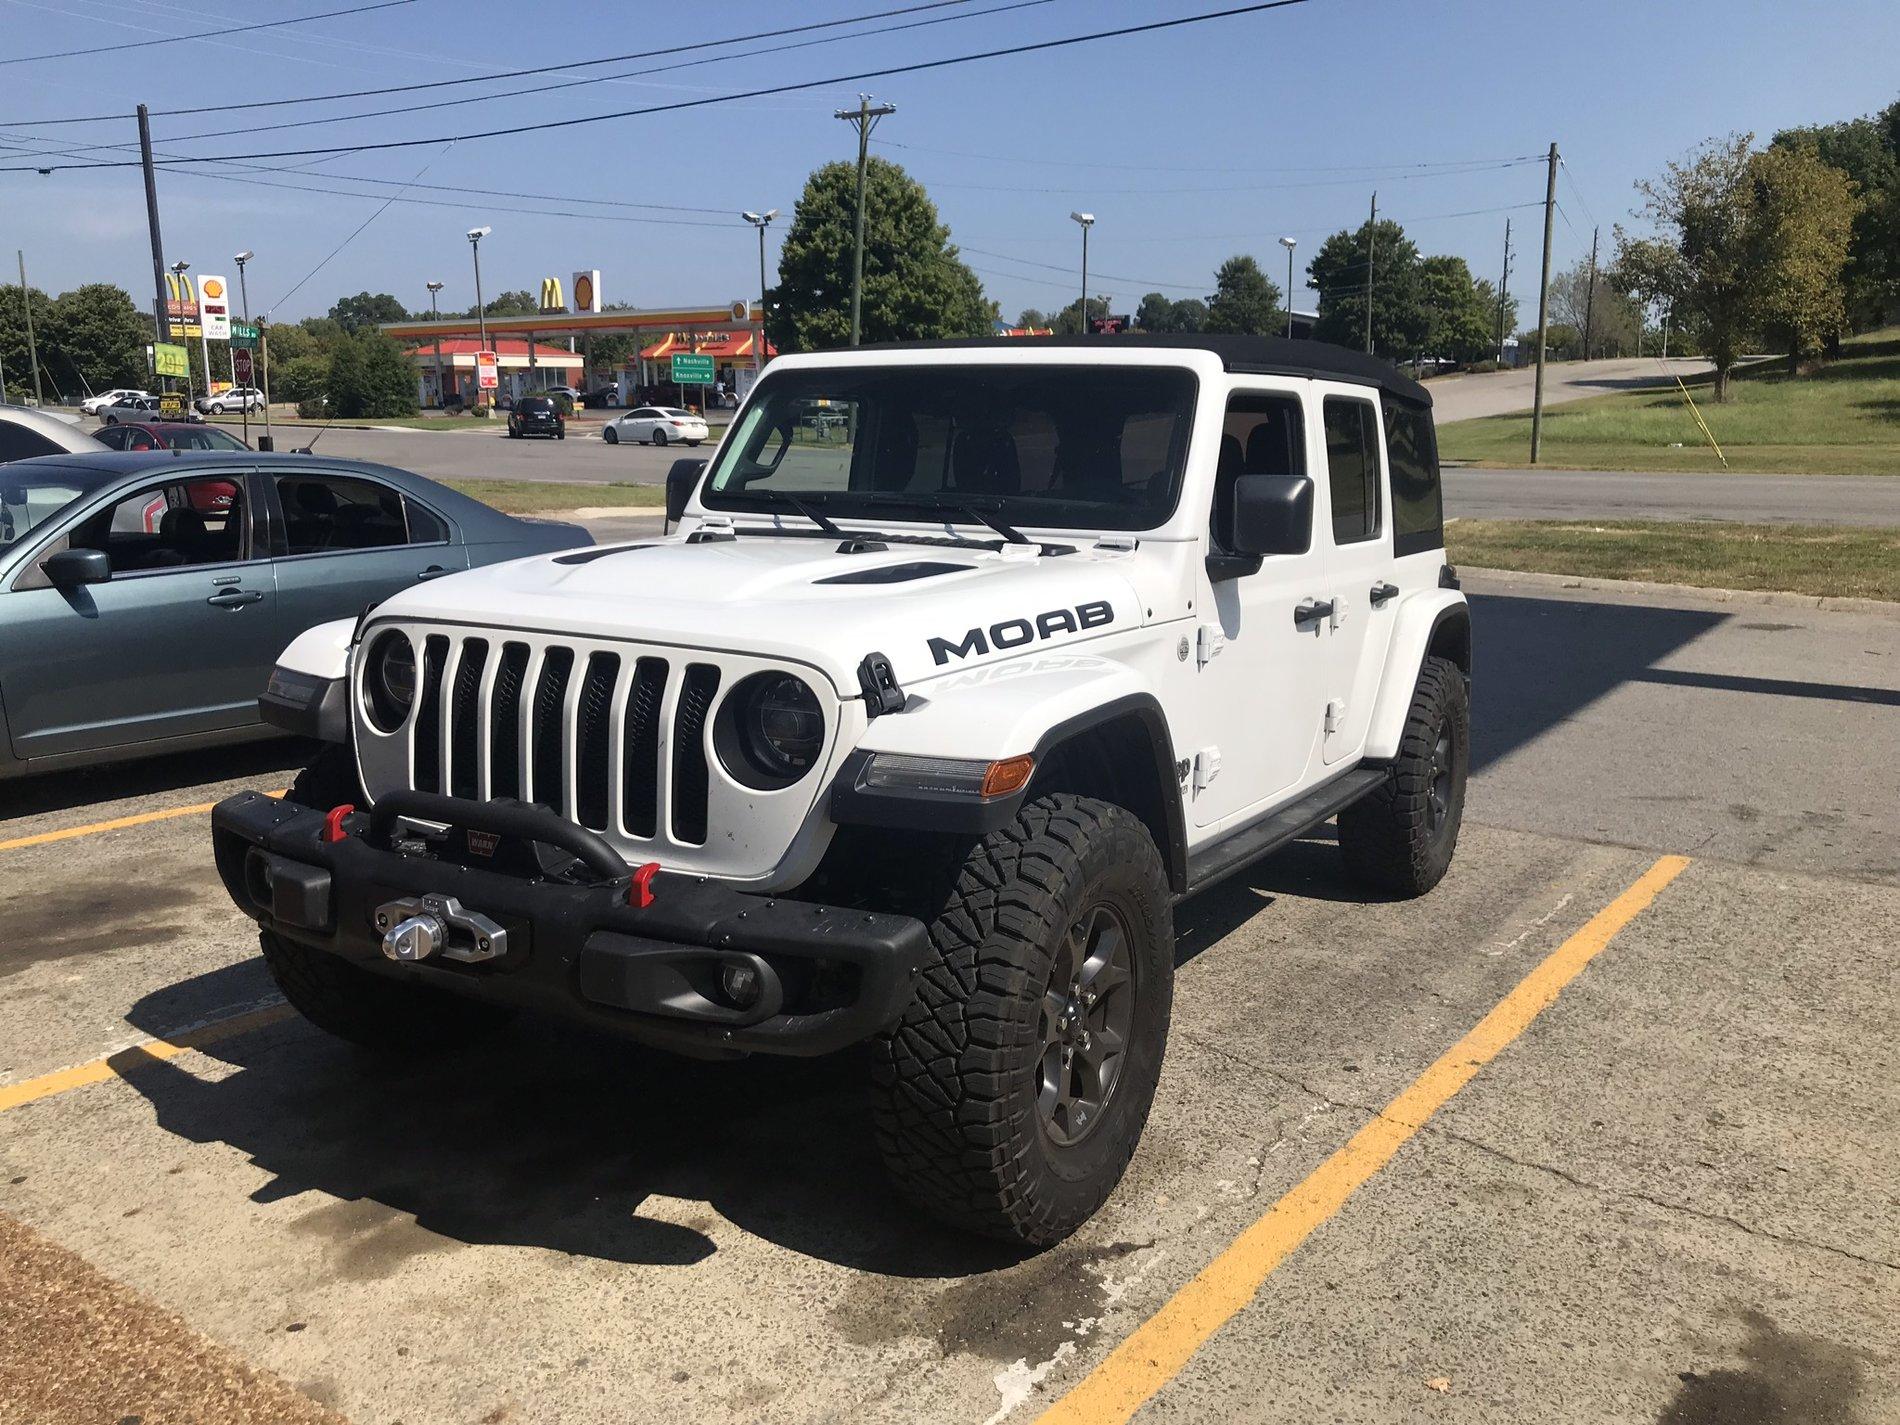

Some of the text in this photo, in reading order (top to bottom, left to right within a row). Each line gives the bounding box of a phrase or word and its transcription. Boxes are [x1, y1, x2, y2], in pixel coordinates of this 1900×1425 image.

[235, 358, 251, 373] STOP
[682, 356, 710, 366] Nashville
[674, 371, 702, 380] Knoxville
[926, 600, 1115, 666] MOAB
[471, 837, 494, 850] WARN
